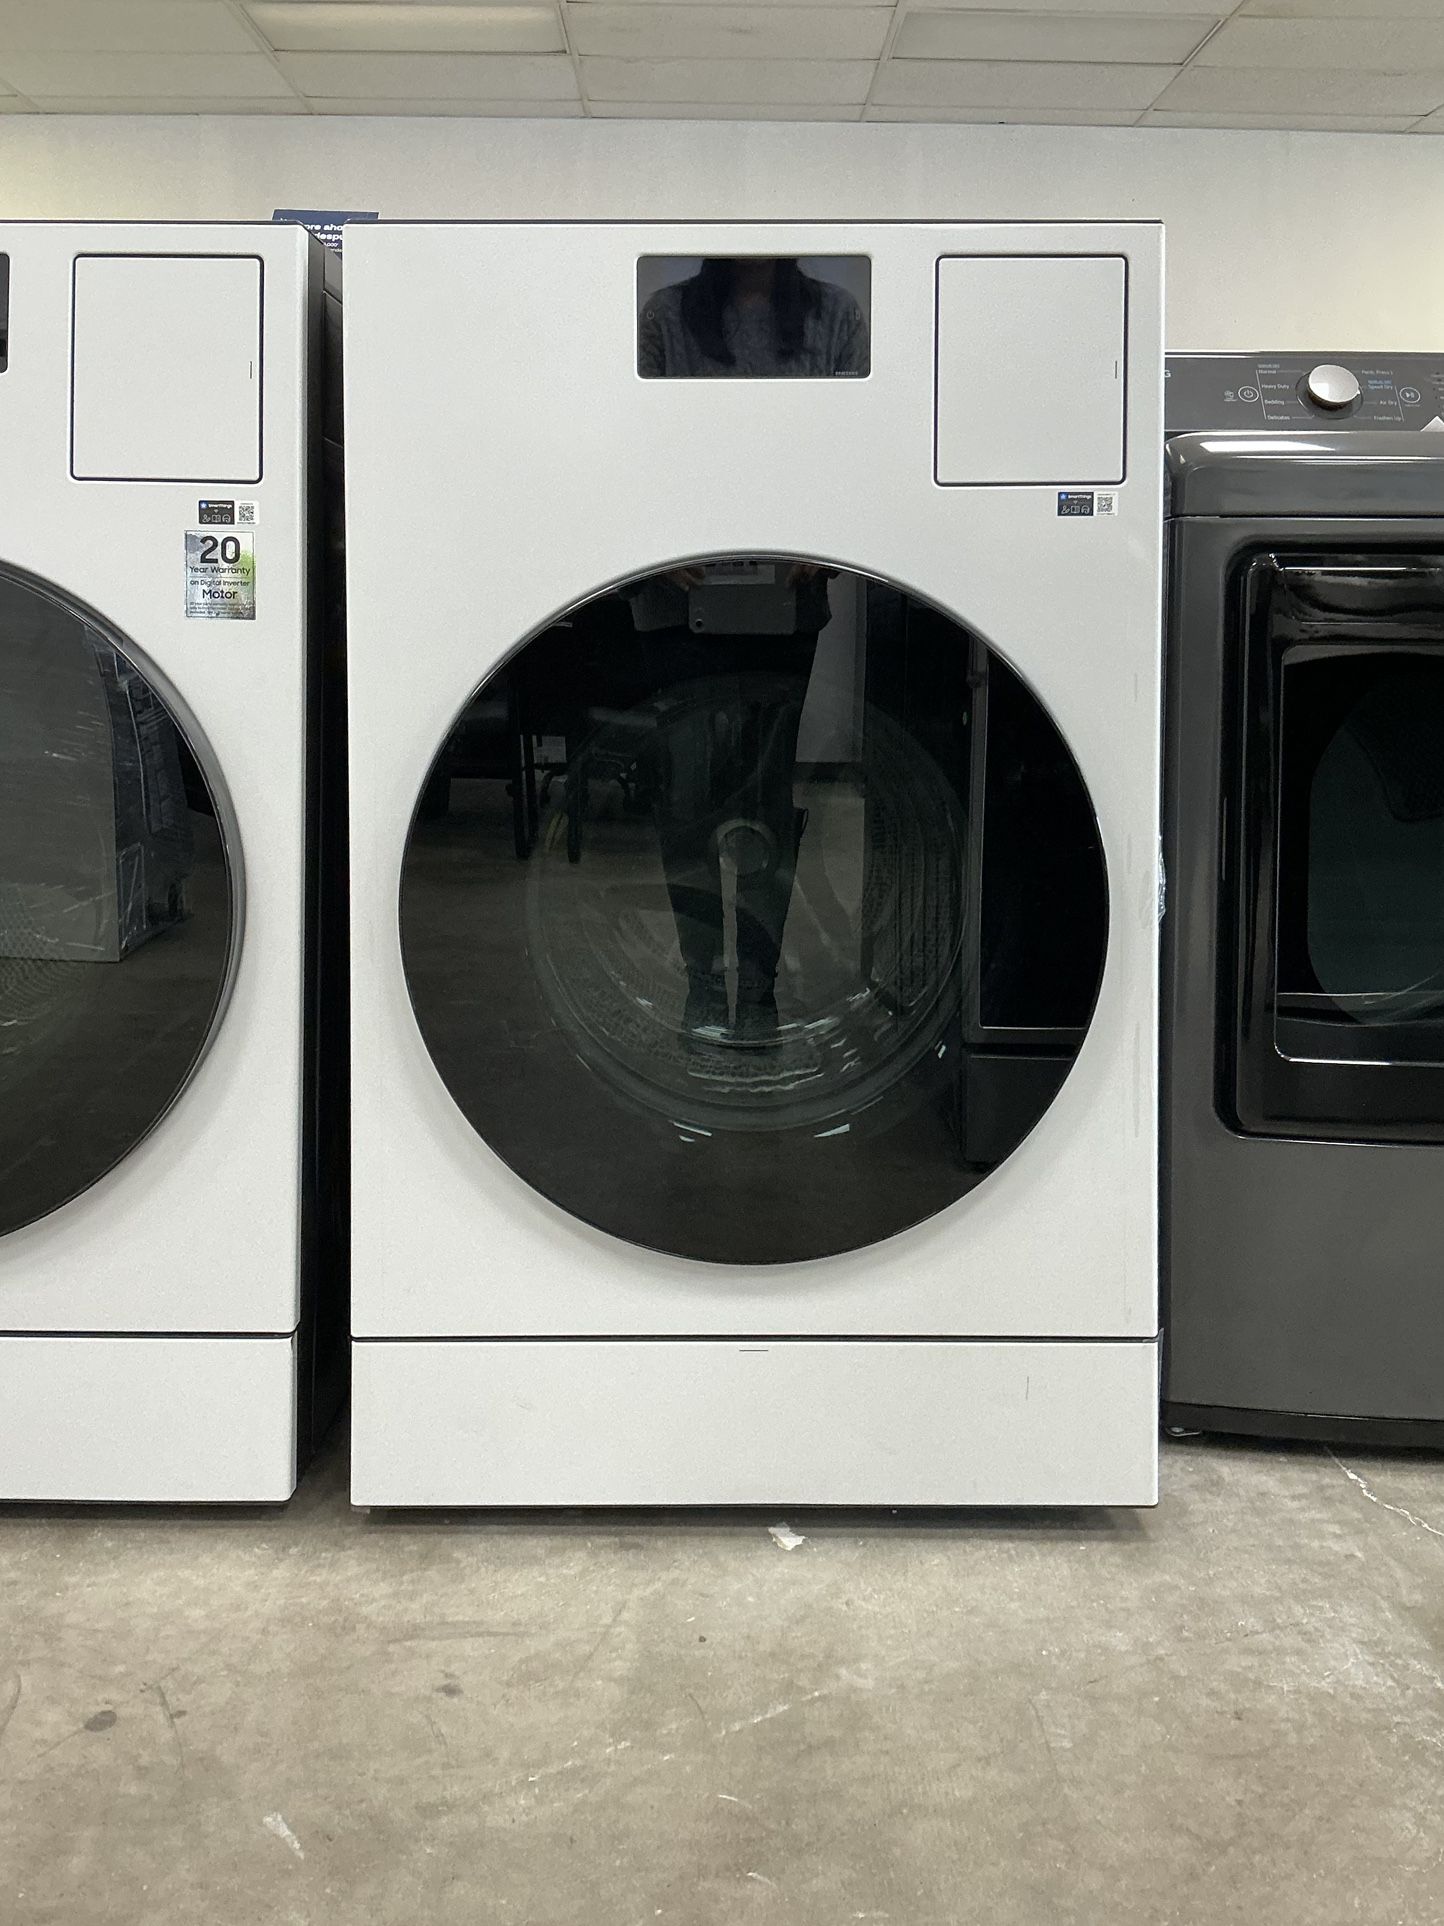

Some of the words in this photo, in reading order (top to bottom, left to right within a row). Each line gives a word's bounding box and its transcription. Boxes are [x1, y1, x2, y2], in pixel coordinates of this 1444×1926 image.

[200, 536, 240, 564] 20
[189, 566, 208, 574] Year
[210, 566, 250, 576] Warranty
[200, 580, 221, 588] Digital
[202, 589, 238, 599] Motor
